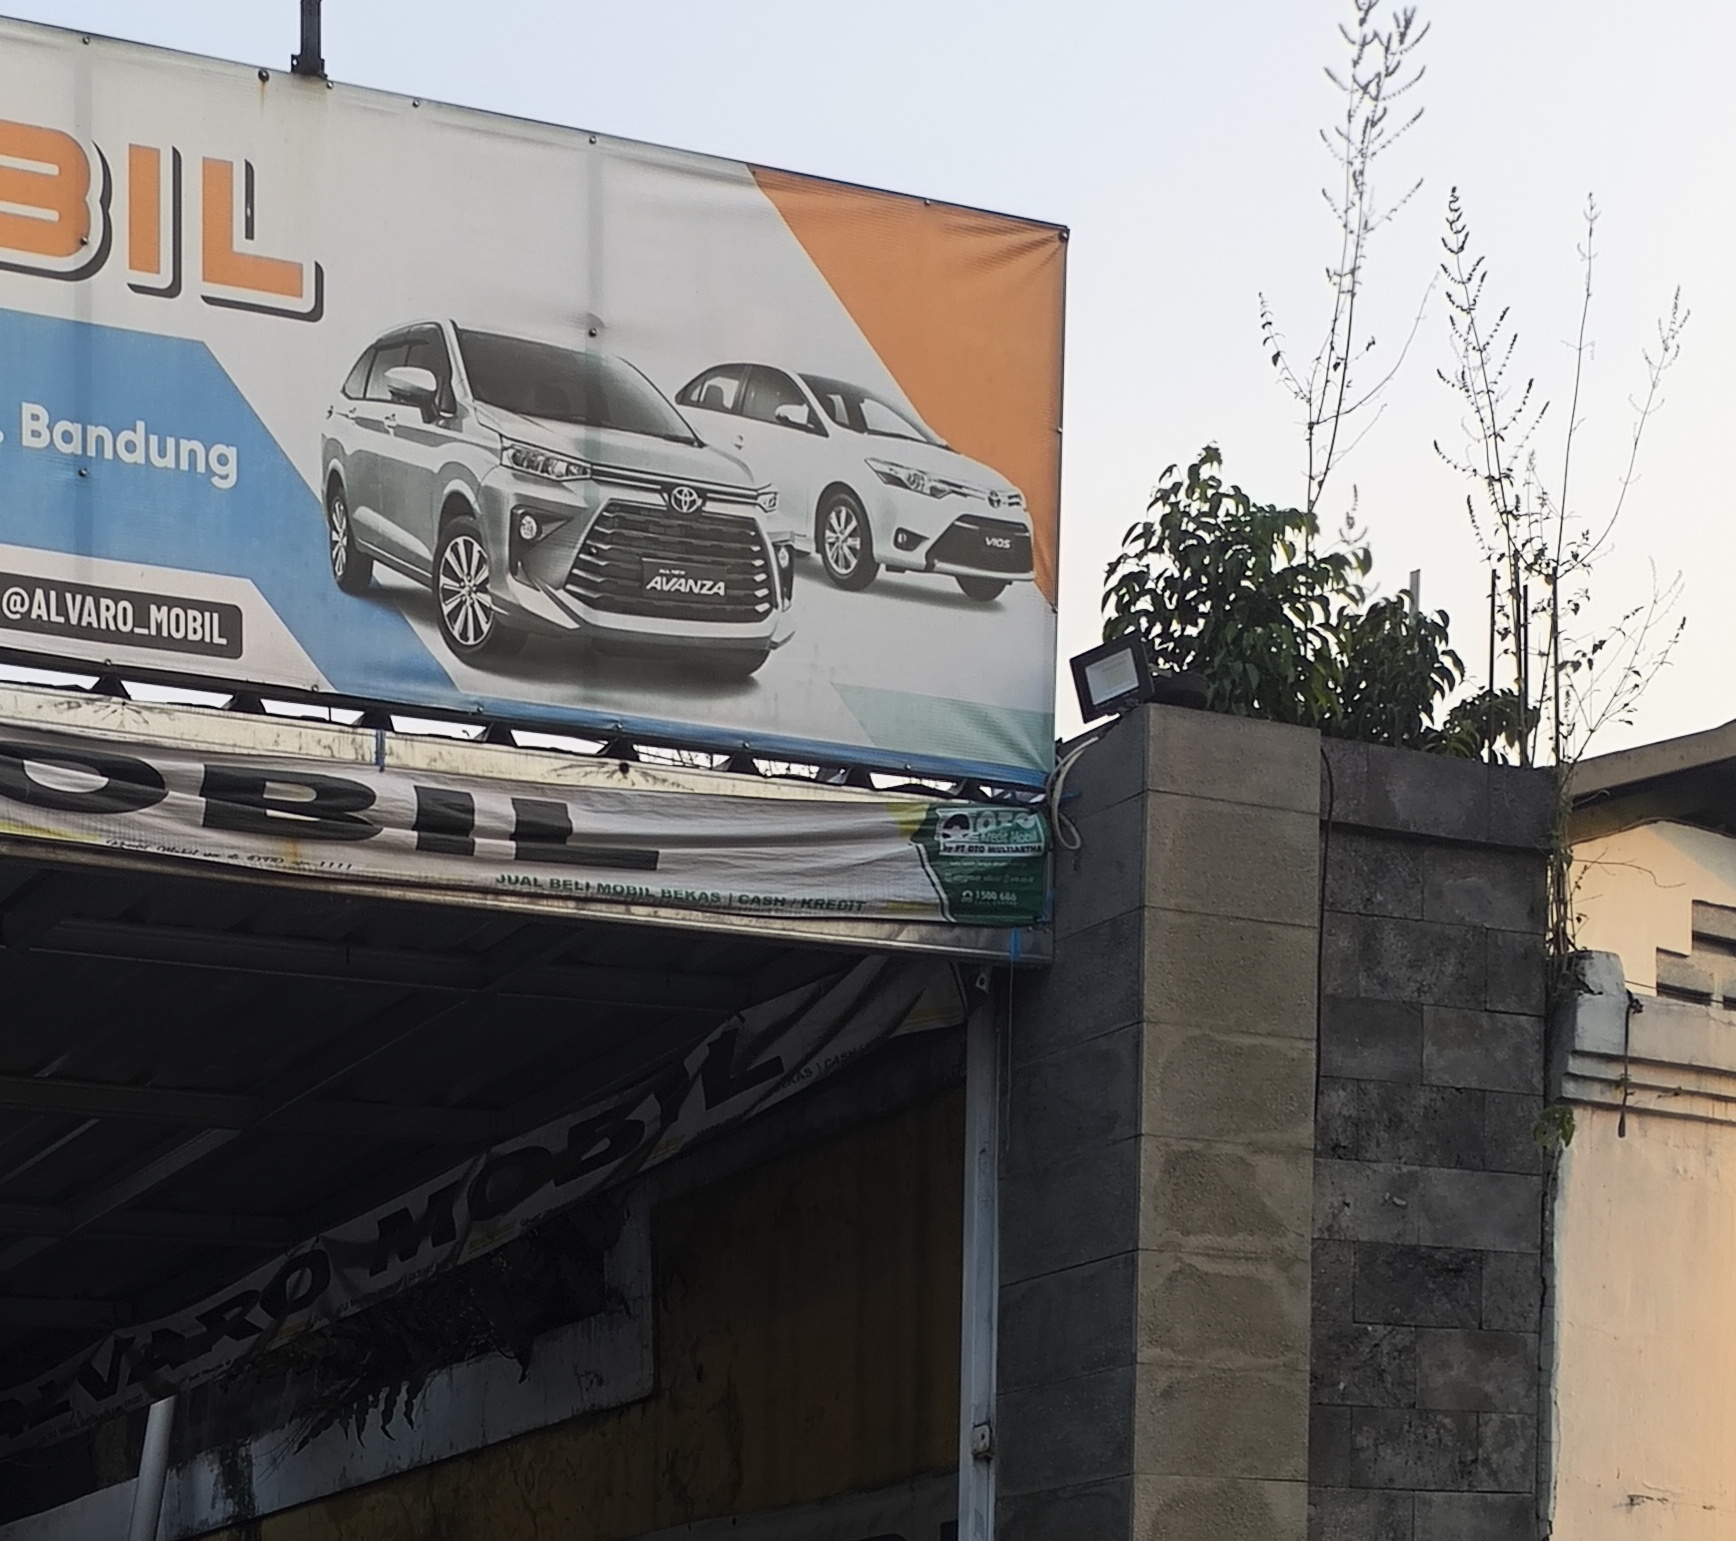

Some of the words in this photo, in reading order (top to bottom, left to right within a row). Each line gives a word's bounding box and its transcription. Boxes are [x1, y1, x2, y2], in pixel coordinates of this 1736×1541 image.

[19, 402, 238, 490] Bandung
[985, 536, 1012, 549] VIOS
[646, 576, 725, 596] AVANZA
[0, 585, 229, 647] @ALVARO_MOBIL
[495, 874, 543, 889] JUAL
[549, 878, 590, 892] BELI
[596, 881, 654, 898] MOBIL
[661, 887, 721, 904] BEKAS
[738, 893, 784, 907] CASH
[800, 897, 867, 912] KREDIT
[975, 889, 997, 900] 1500
